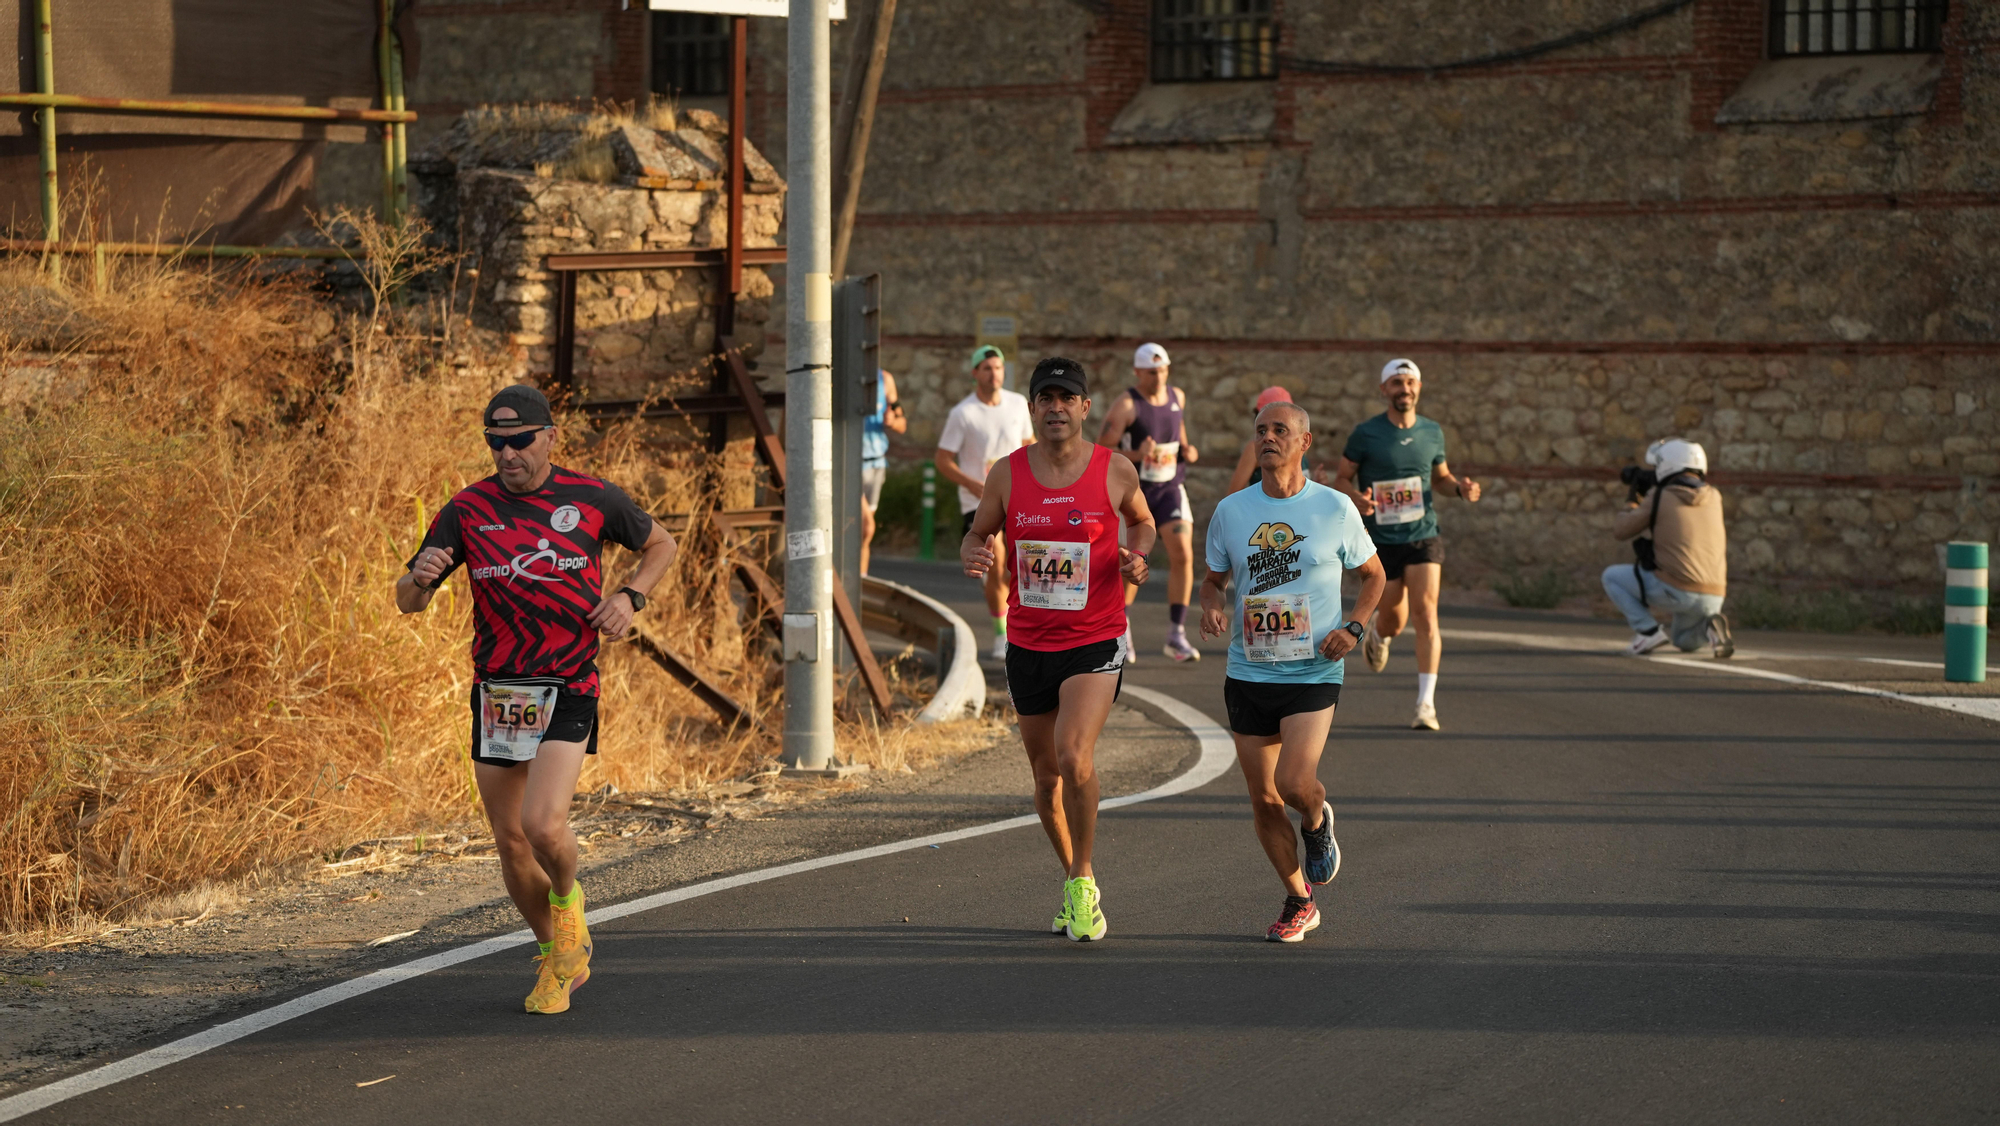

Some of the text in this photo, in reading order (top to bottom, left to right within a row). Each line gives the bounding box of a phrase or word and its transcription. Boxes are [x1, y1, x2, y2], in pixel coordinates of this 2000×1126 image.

[1385, 490, 1413, 505] 303
[1023, 515, 1051, 524] califas
[1248, 522, 1297, 551] 40
[557, 556, 588, 570] SPORT
[1247, 548, 1276, 566] MEDIA
[1248, 548, 1301, 581] MARATÓN
[1031, 559, 1073, 579] 444
[1253, 611, 1295, 632] 201
[494, 703, 537, 726] 256
